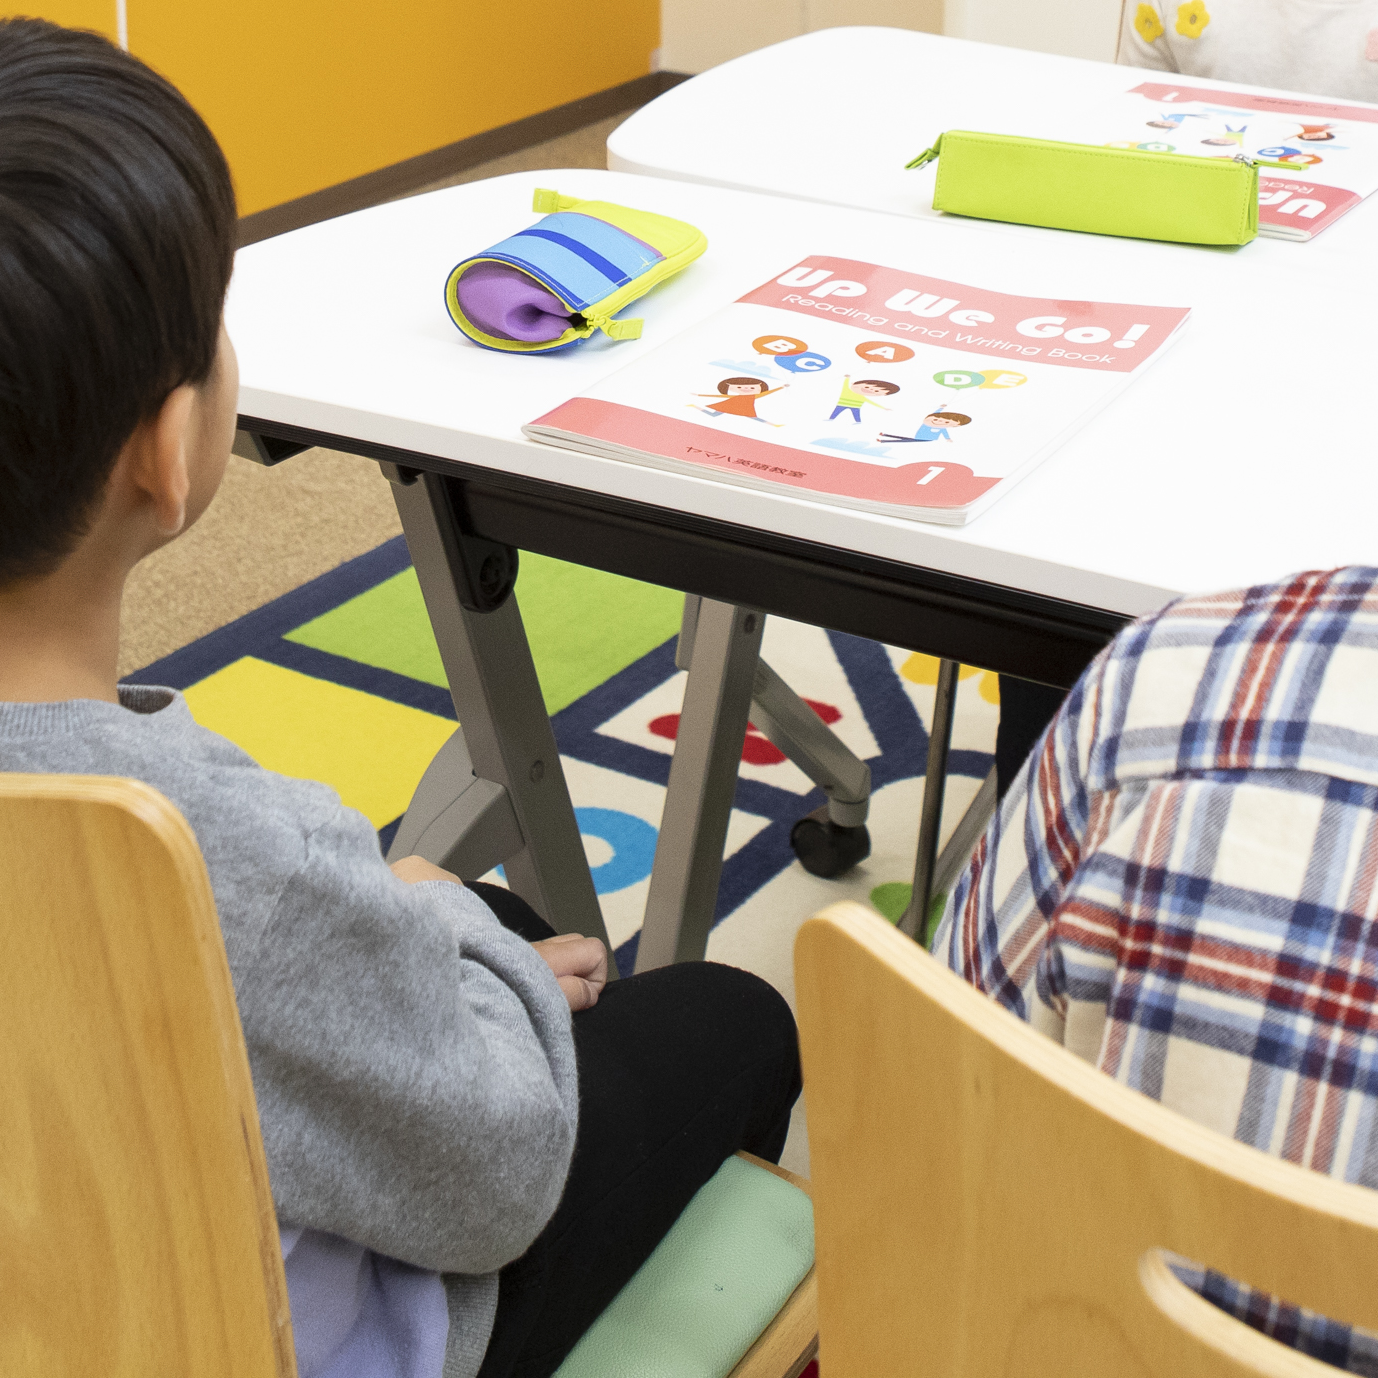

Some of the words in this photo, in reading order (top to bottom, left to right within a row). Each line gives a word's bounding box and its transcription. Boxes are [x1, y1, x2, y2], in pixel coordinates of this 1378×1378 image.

[776, 266, 868, 298] Up
[884, 288, 995, 327] We
[1015, 316, 1151, 349] Go!
[782, 294, 890, 326] Reading
[894, 322, 950, 339] and
[954, 333, 1042, 356] Writing
[1047, 348, 1117, 365] Book
[762, 339, 797, 353] B
[867, 346, 897, 360] A
[795, 357, 825, 371] C
[944, 373, 972, 386] D
[992, 373, 1025, 386] E
[916, 465, 946, 486] 1
